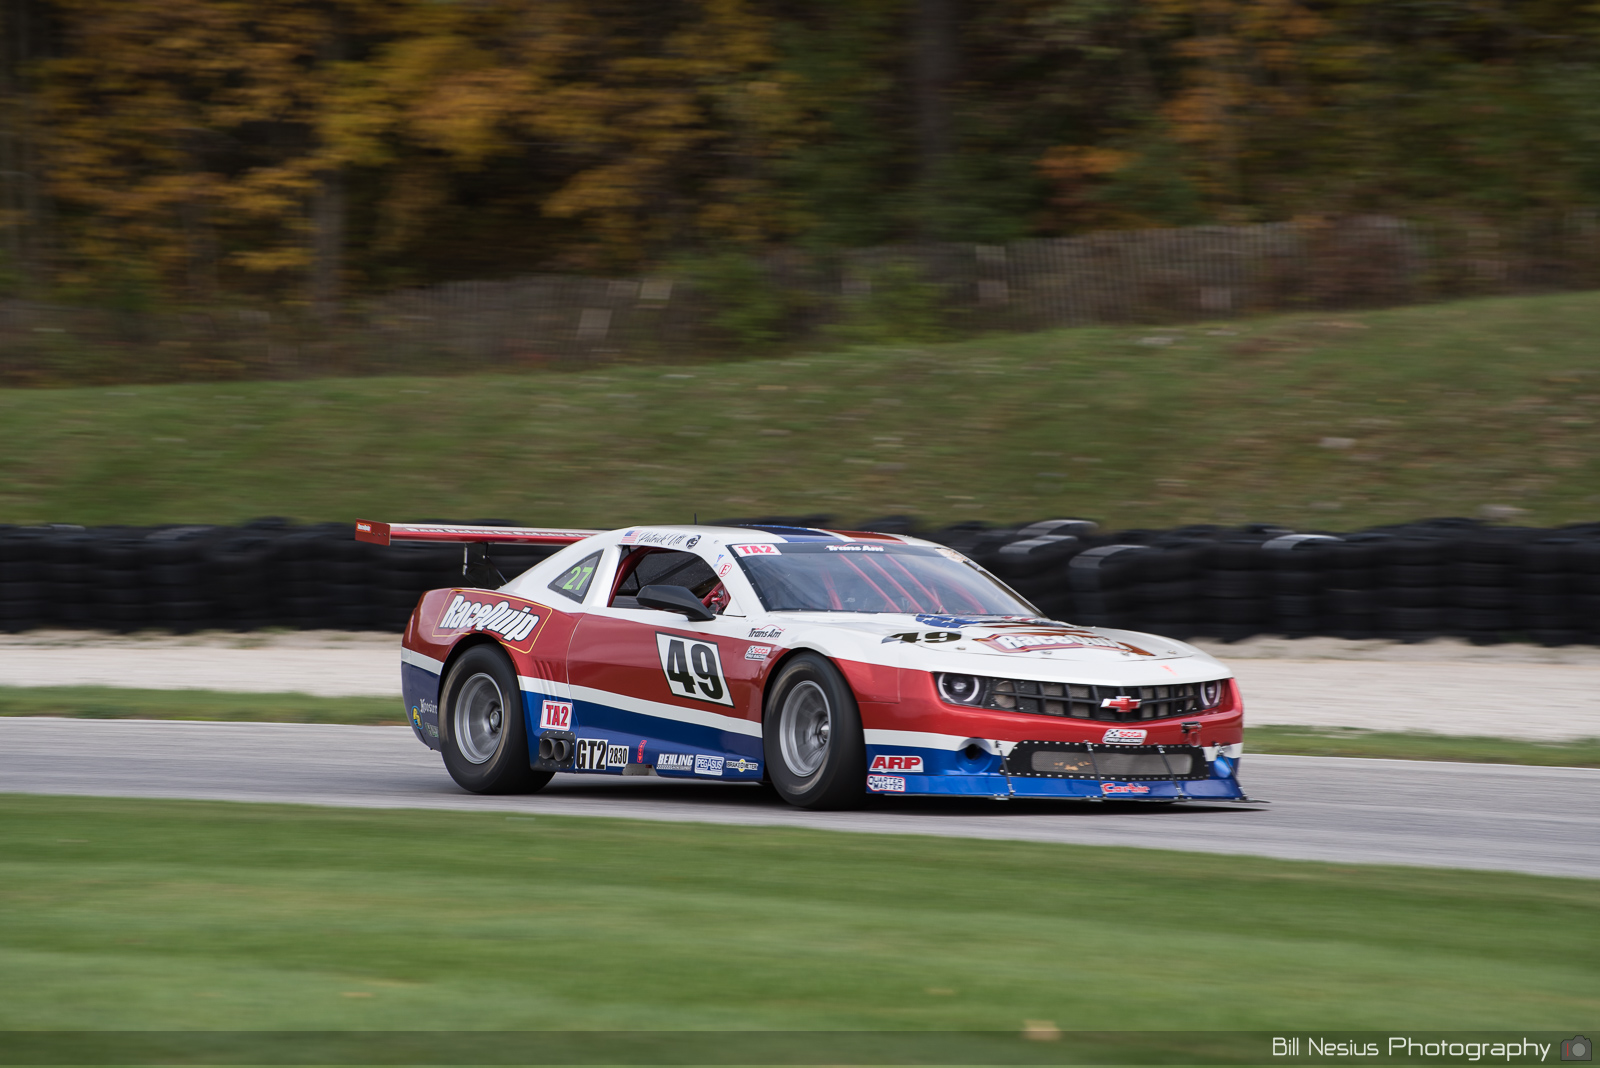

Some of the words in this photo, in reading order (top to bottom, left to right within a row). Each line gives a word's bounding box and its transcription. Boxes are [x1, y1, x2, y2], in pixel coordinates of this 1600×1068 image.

[739, 545, 775, 554] TA2
[562, 566, 593, 591] 27
[438, 594, 540, 642] RaceQuip
[748, 628, 768, 638] Trans
[767, 628, 782, 638] Am
[881, 631, 962, 644] 49
[667, 639, 724, 700] 49
[546, 704, 569, 727] TA2
[576, 740, 606, 770] GT2
[609, 747, 628, 765] 2830
[658, 753, 694, 766] BEHLING
[697, 758, 722, 771] PEGASUS
[871, 756, 921, 769] ARP
[868, 775, 903, 784] QUARTER
[873, 782, 903, 790] MASTER
